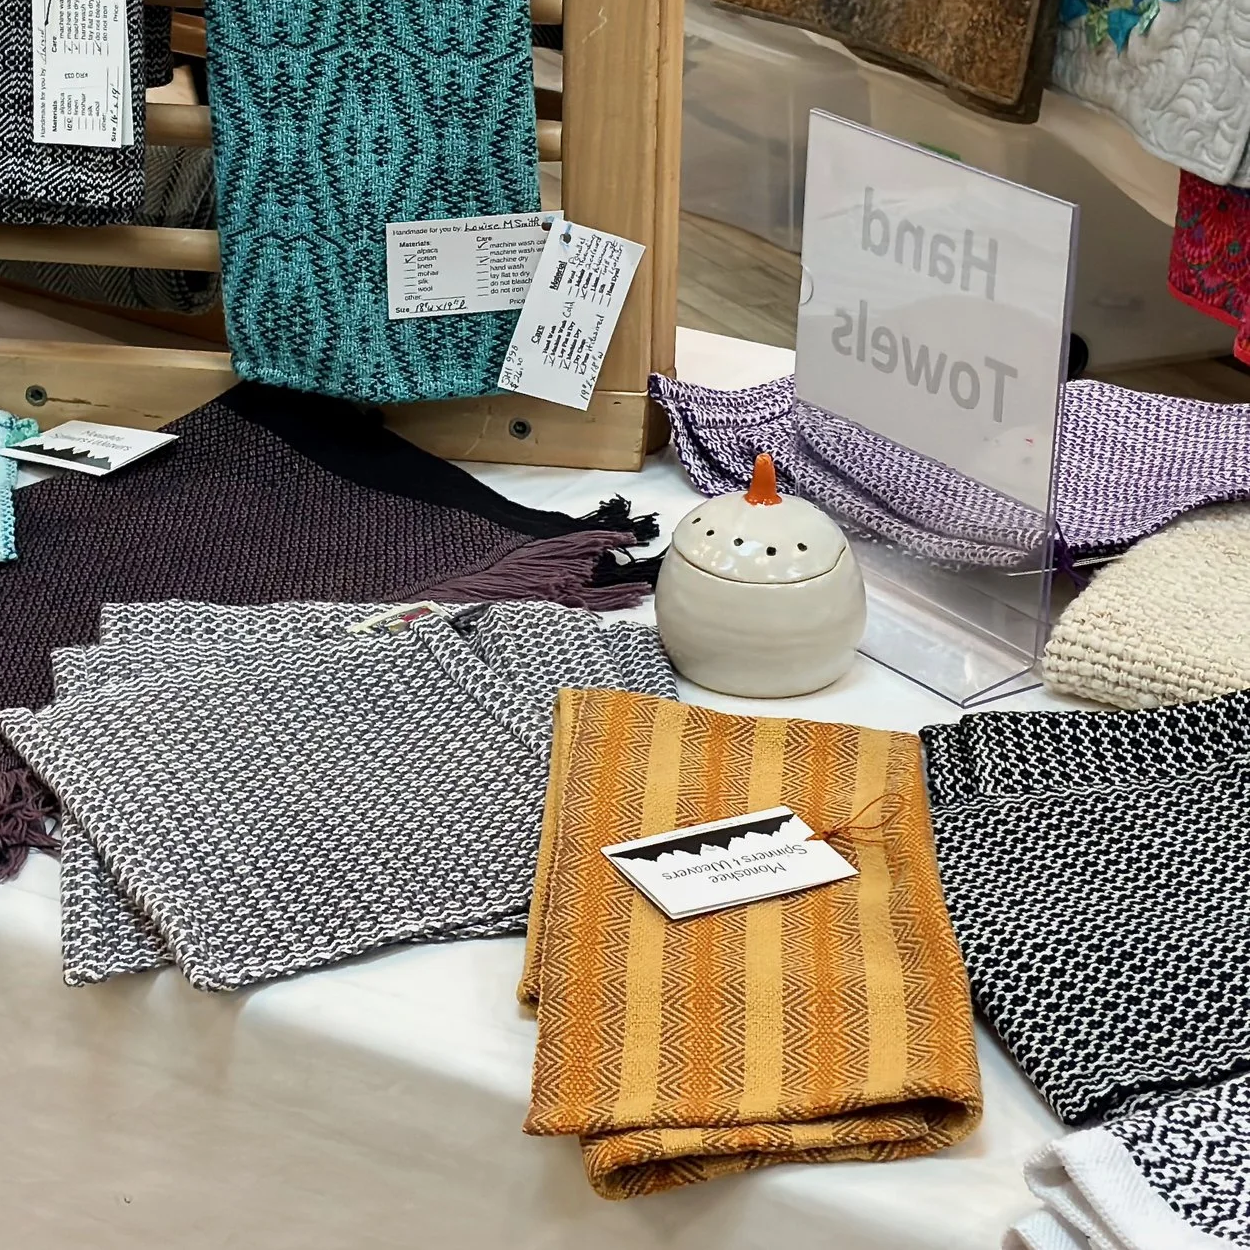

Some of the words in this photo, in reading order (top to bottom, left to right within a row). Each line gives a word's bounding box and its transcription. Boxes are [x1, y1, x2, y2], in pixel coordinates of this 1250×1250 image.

[392, 228, 428, 236] Handmade
[439, 227, 452, 235] you
[464, 222, 500, 232] Louise
[503, 219, 514, 230] M
[513, 216, 541, 229] Smith
[489, 241, 517, 249] machine
[489, 256, 518, 264] machine
[517, 255, 529, 263] dry
[489, 264, 507, 272] hand
[519, 270, 531, 278] dry
[511, 277, 533, 285] bleach
[549, 260, 568, 291] Material
[741, 843, 808, 863] Spinners
[662, 860, 732, 880] Weavers
[708, 862, 787, 883] Monashee
